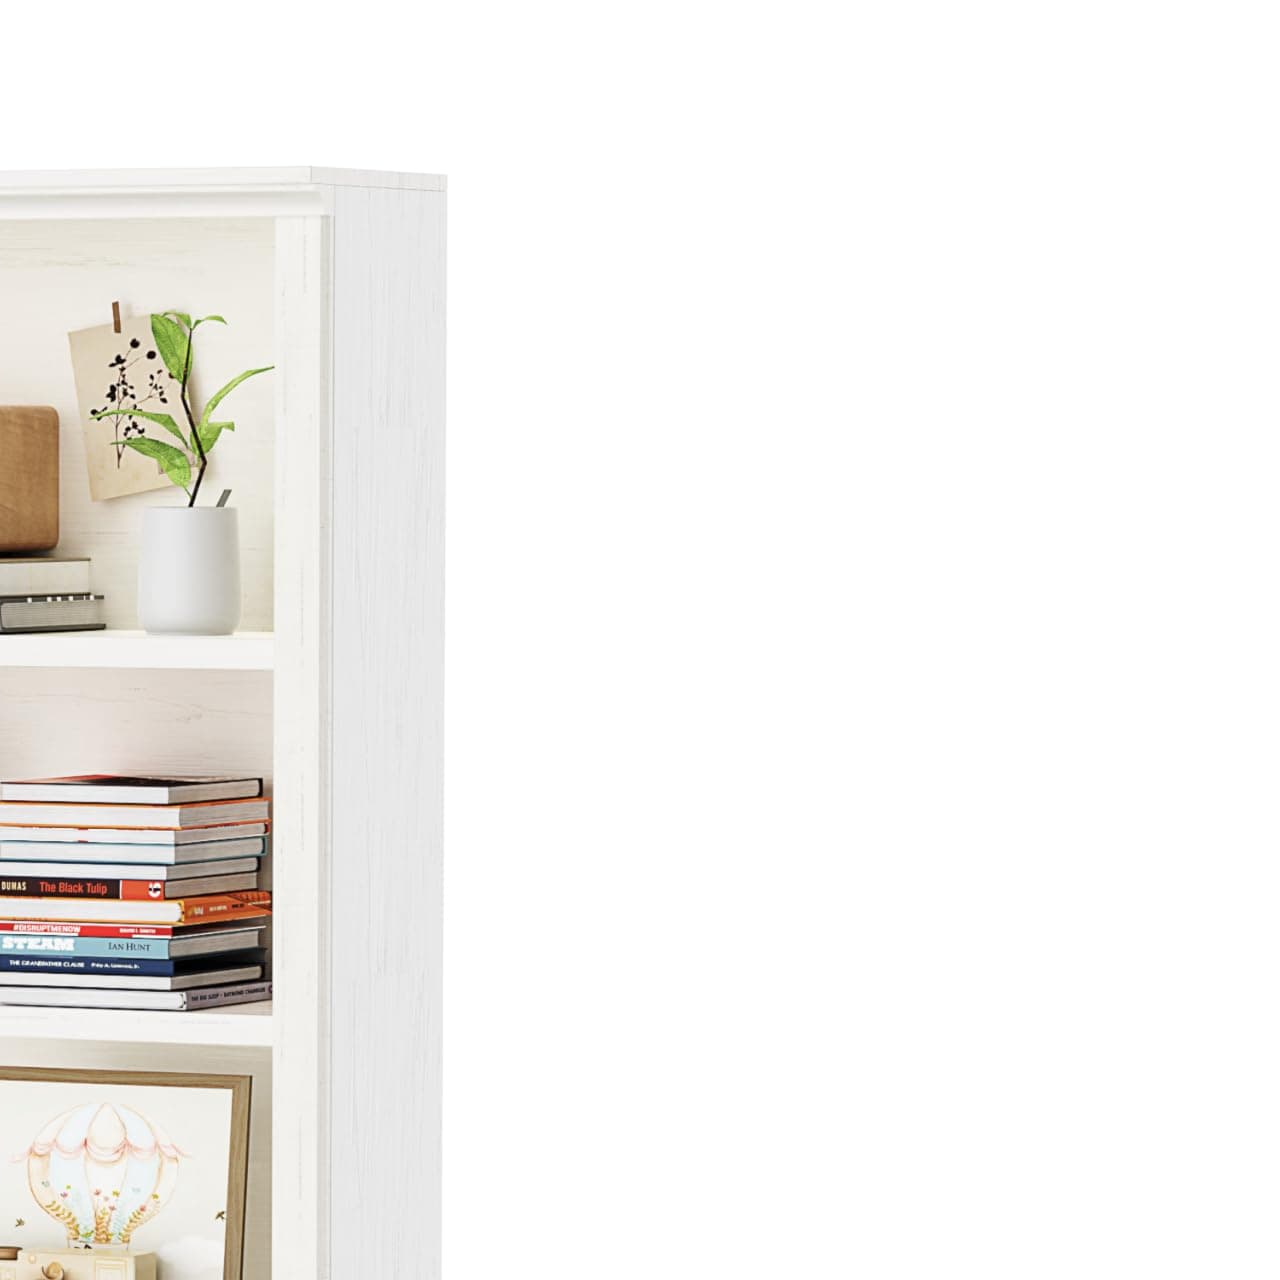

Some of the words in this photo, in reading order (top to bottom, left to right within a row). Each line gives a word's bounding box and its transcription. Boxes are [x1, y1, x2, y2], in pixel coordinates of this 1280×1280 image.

[1, 881, 27, 891] DUMAS
[40, 881, 56, 892] The
[59, 882, 84, 894] Black
[87, 883, 108, 896] Tulip
[14, 924, 81, 933] #DISRUPTMENOW
[1, 936, 75, 951] STEAM
[109, 942, 124, 951] IAN
[126, 942, 151, 952] HUNT
